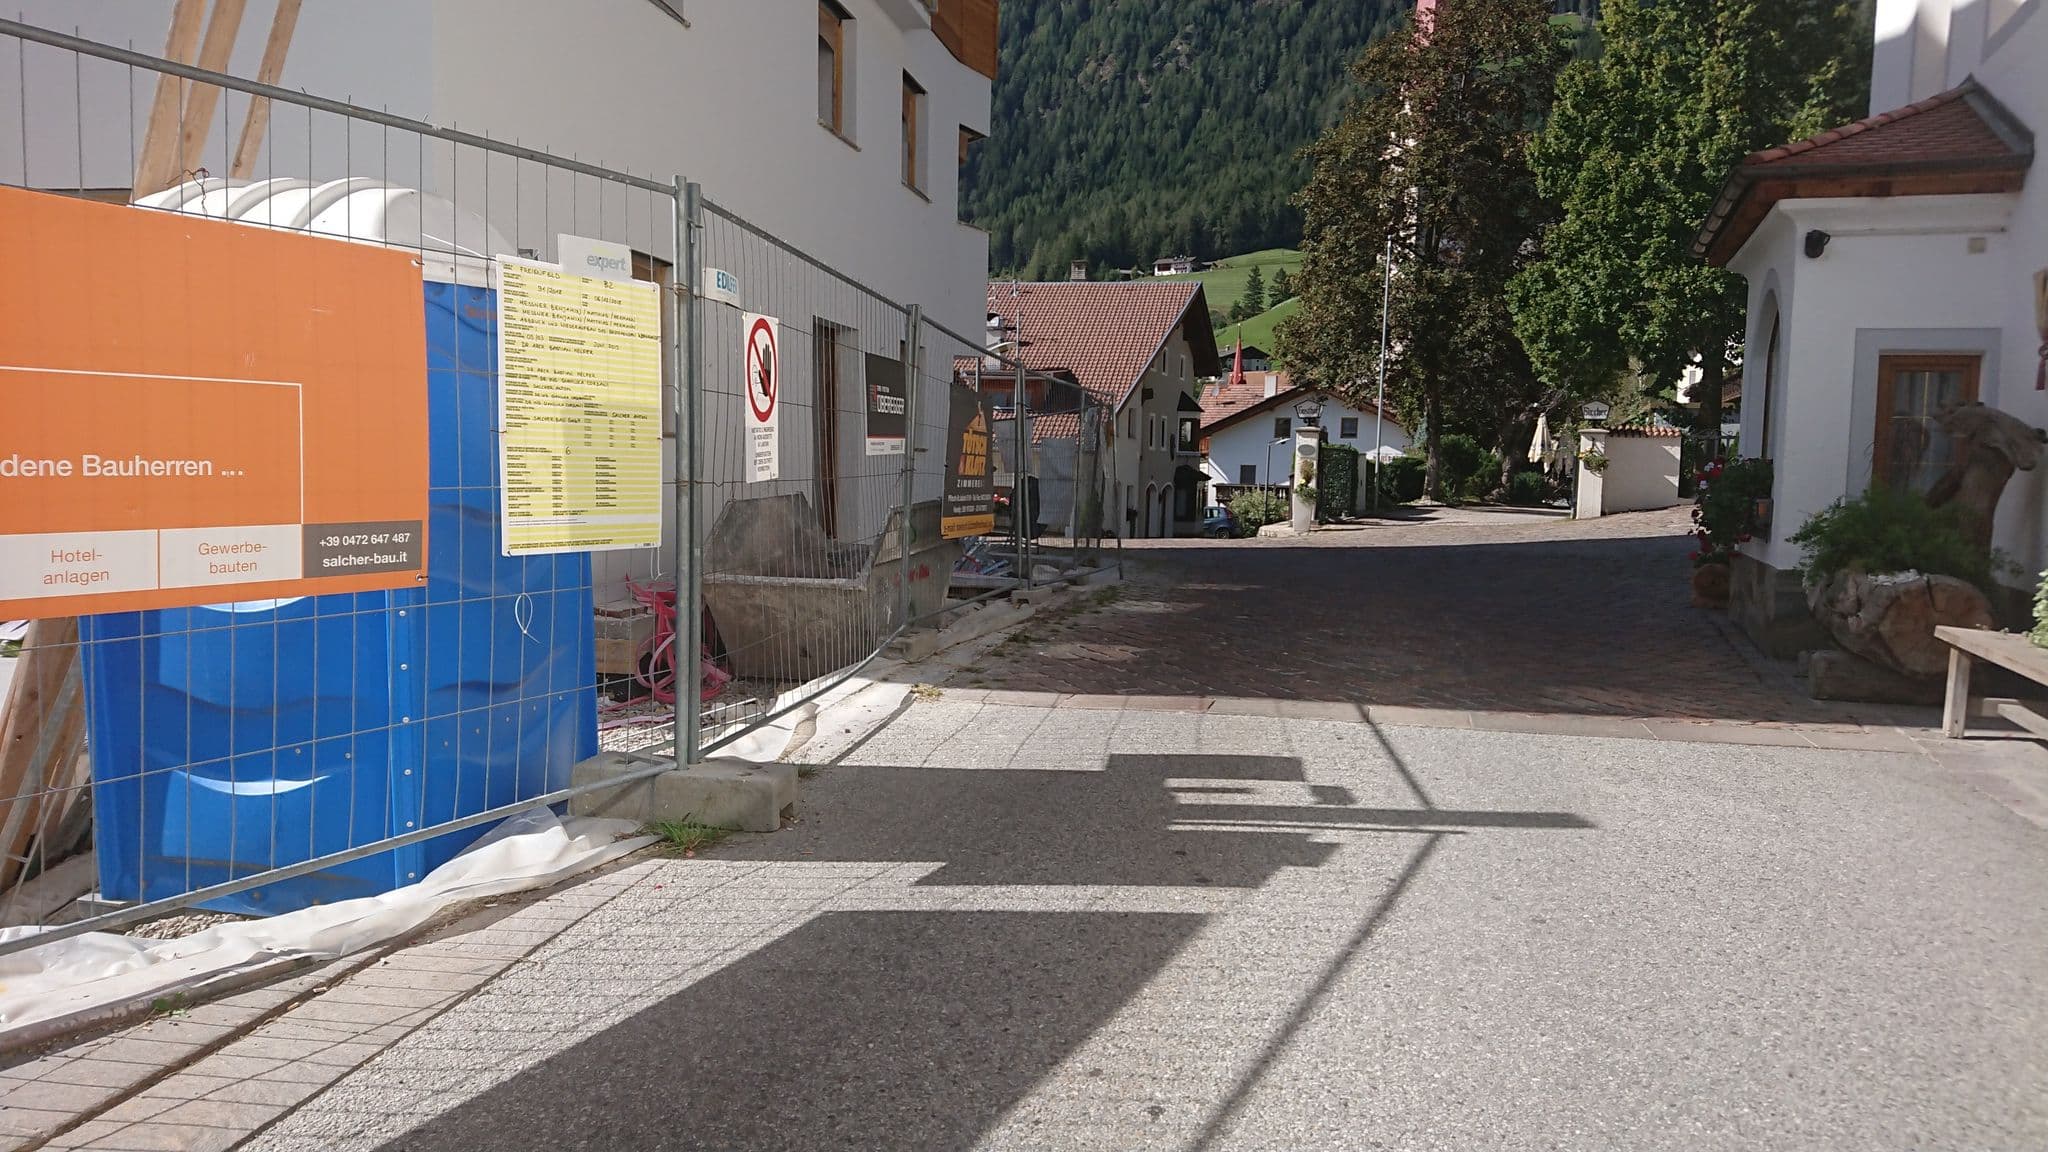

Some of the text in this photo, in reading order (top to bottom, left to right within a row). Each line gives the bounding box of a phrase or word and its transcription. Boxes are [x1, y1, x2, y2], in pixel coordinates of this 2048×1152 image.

[587, 255, 626, 272] expert
[82, 454, 213, 477] Bauherren
[319, 532, 411, 547] +39 0472 647 487
[50, 548, 103, 563] Hotel-
[198, 541, 269, 556] Gewerbe-
[322, 551, 408, 568] salcher-bau.it
[209, 561, 257, 575] bauten
[43, 568, 110, 586] anlagen
